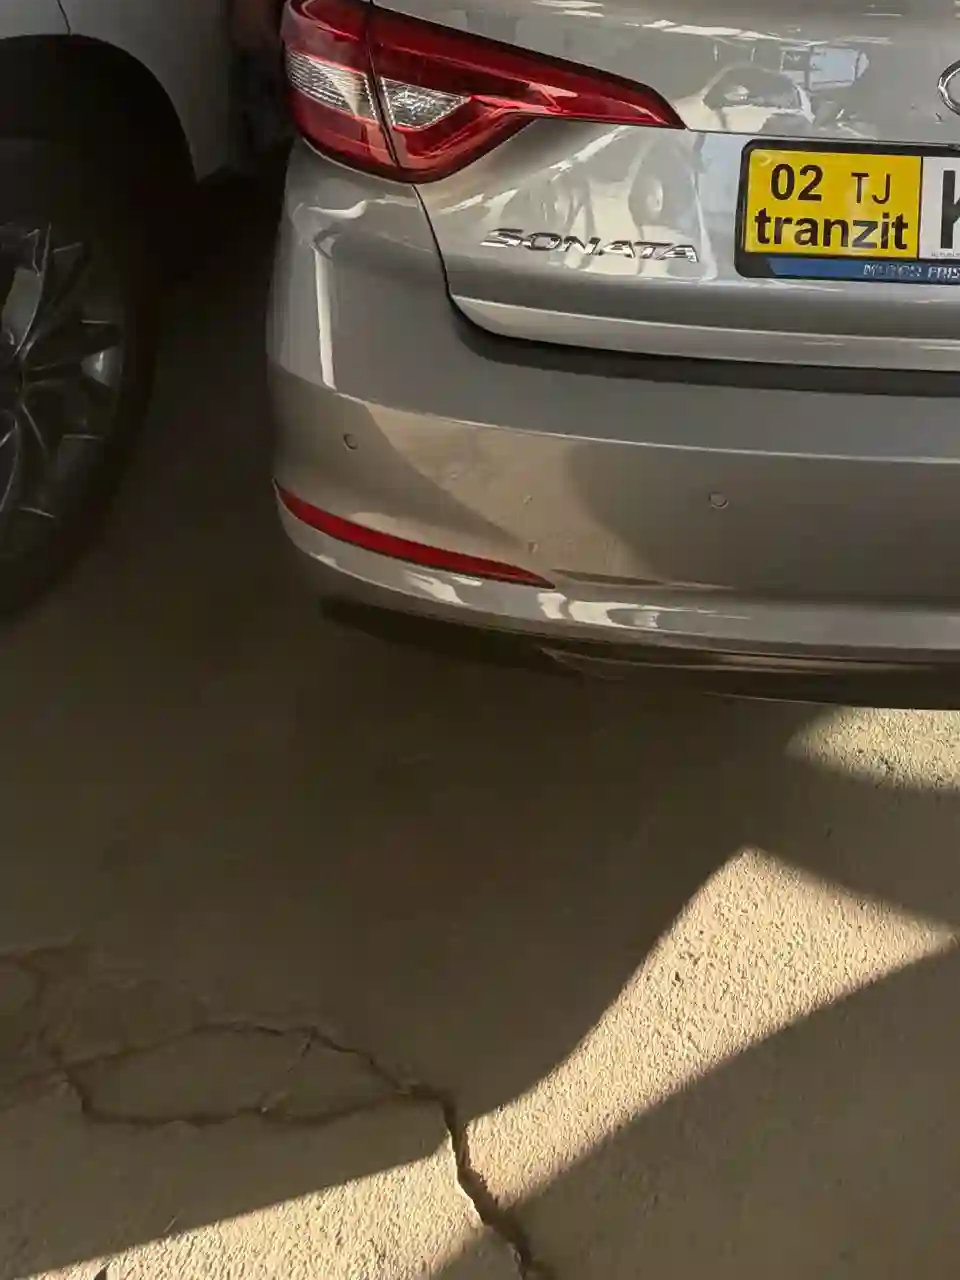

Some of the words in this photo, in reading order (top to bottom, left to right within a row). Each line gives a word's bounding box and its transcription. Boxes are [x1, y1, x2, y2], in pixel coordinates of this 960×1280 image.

[770, 164, 823, 202] 02
[851, 172, 891, 205] TJ
[480, 227, 700, 263] SONATA
[754, 206, 909, 250] tranzit
